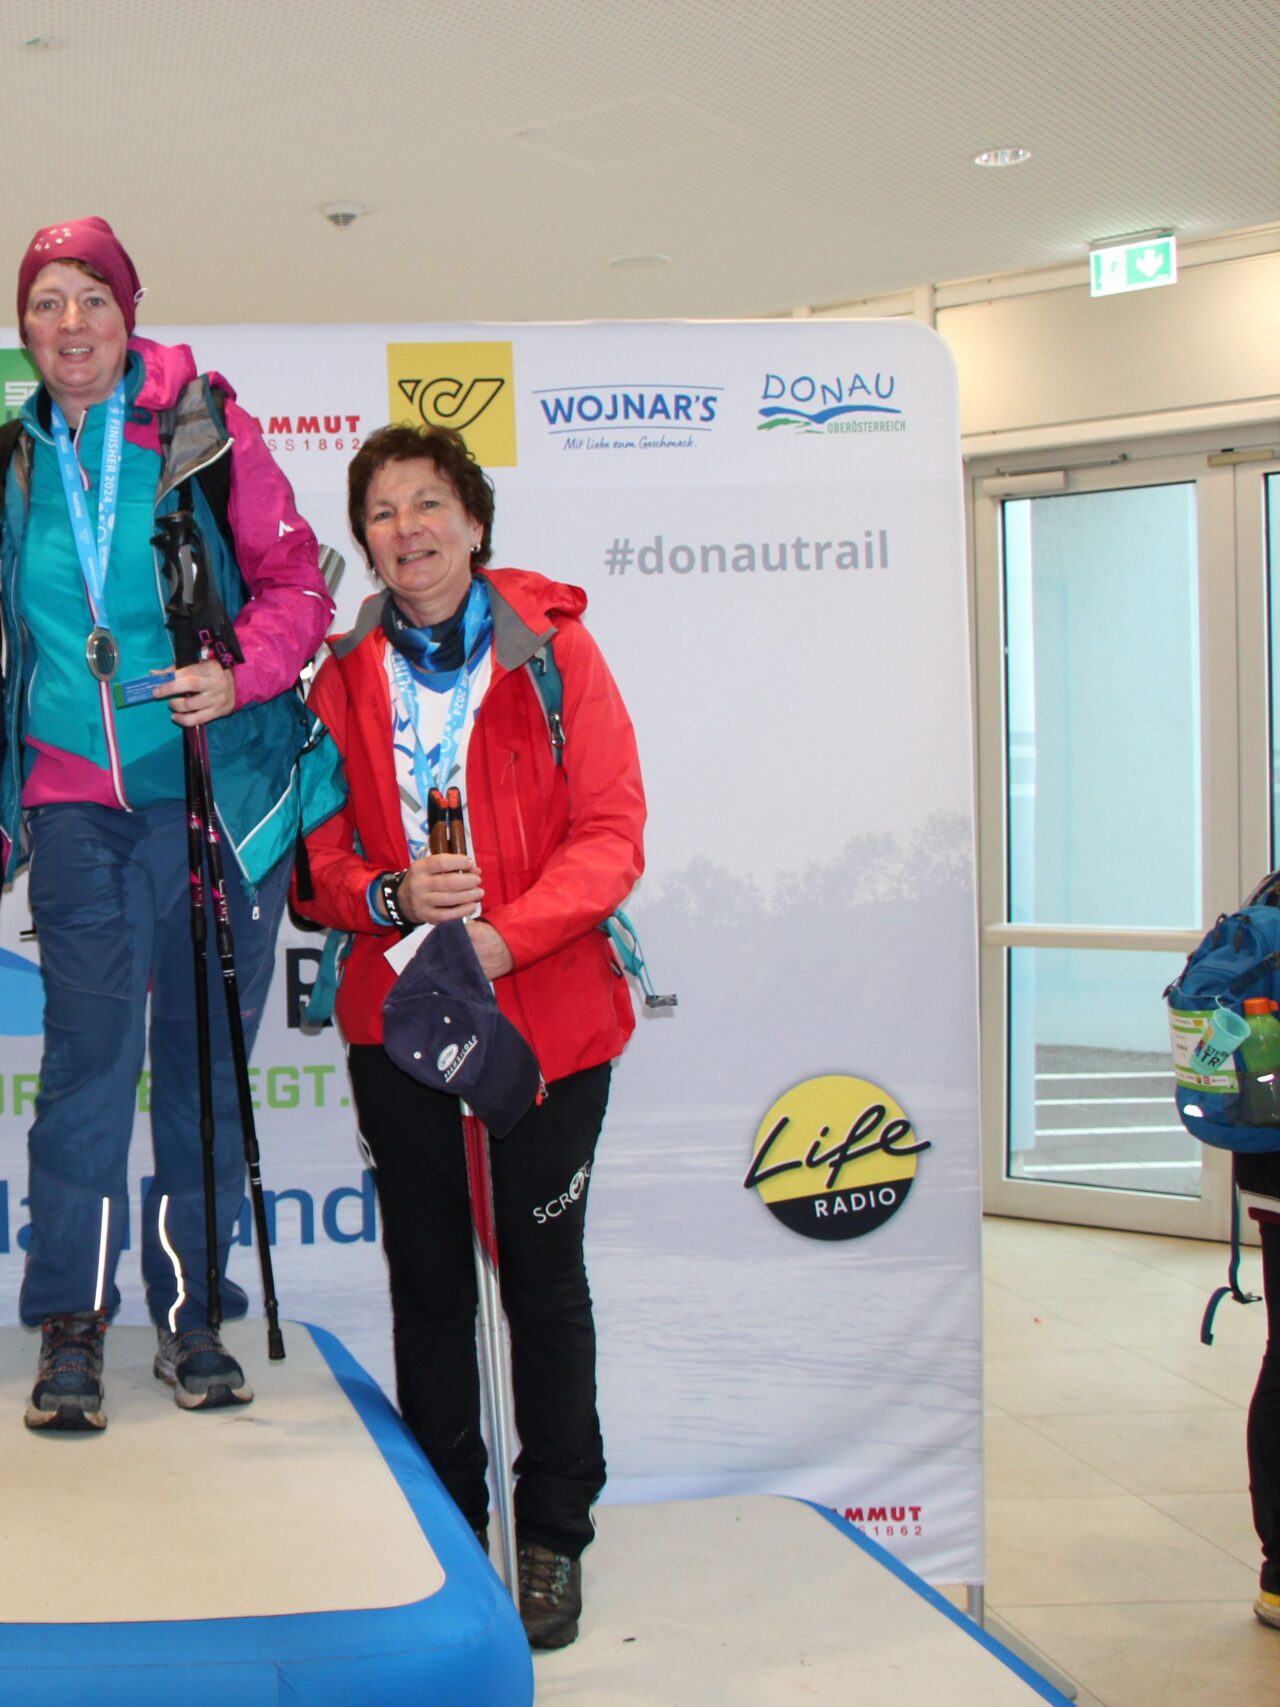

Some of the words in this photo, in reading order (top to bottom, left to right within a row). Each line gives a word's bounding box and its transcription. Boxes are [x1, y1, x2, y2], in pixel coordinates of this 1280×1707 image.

[761, 373, 894, 405] DONAU
[252, 416, 360, 434] MMUT
[540, 394, 717, 425] WOJNAR'S
[563, 437, 584, 450] Mit
[586, 437, 610, 450] Liebe
[612, 440, 635, 449] zum
[638, 435, 698, 450] Geschmack.
[827, 420, 906, 434] OBERÖSTERREICH
[106, 418, 120, 474] FINISHER
[303, 438, 360, 451] 1862
[103, 475, 117, 503] 2024
[604, 529, 889, 576] #donautrail
[383, 886, 404, 926] LEKI
[743, 1104, 931, 1189] Life
[814, 1187, 896, 1218] RADIO
[842, 1506, 922, 1522] MMUT
